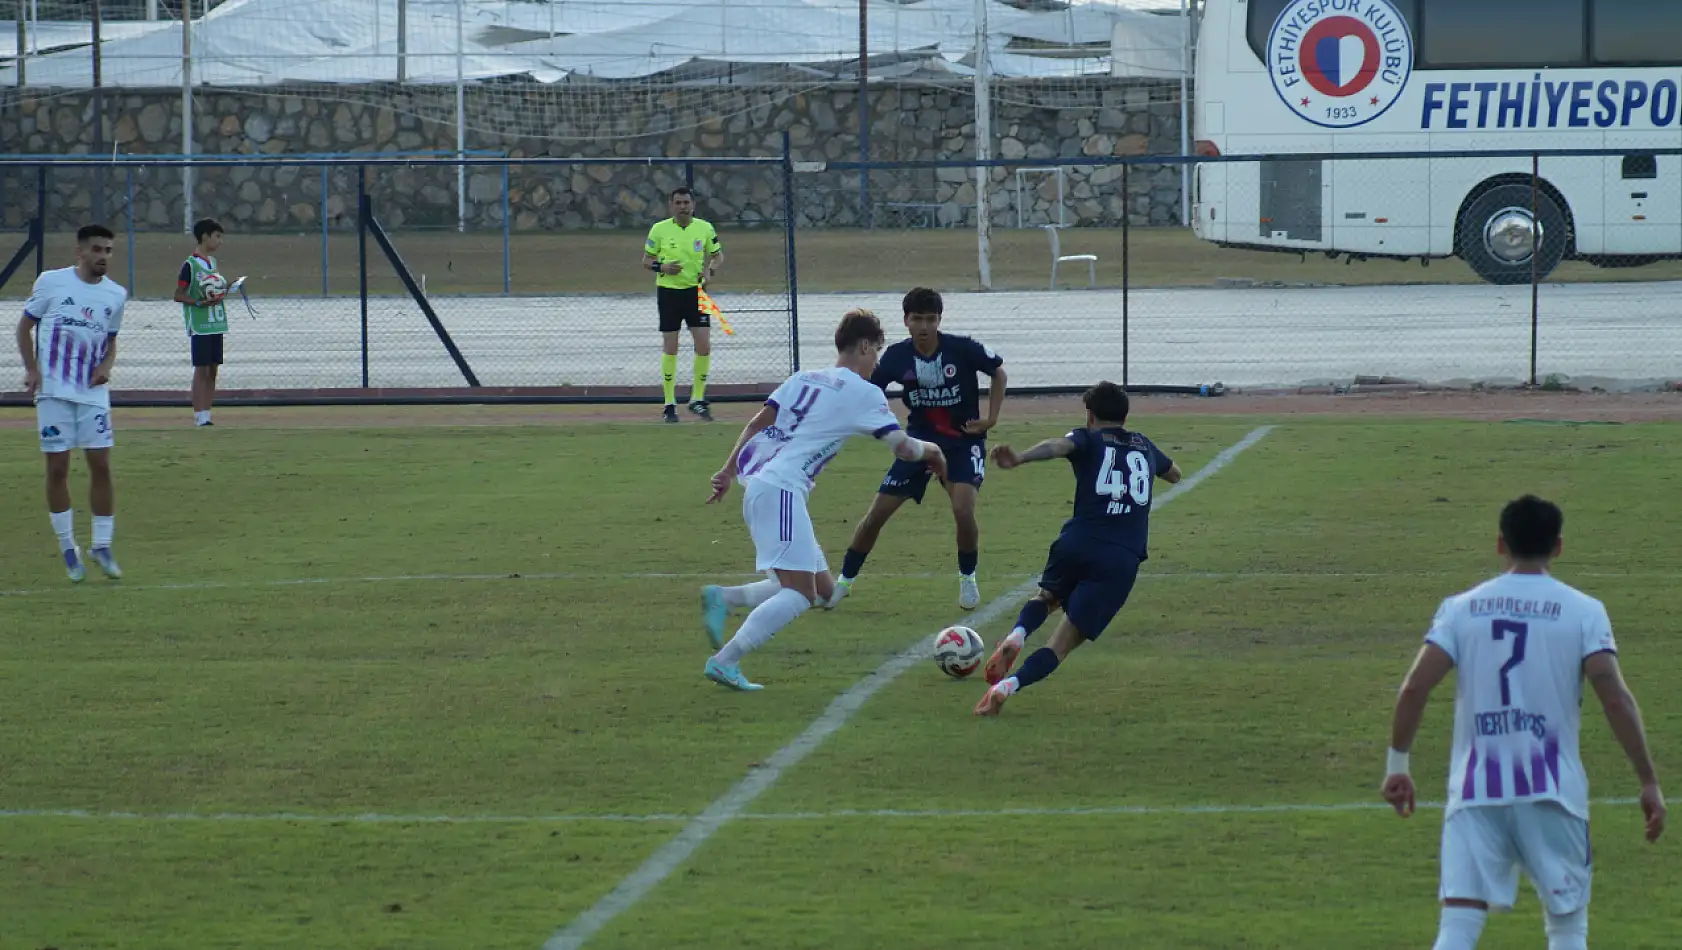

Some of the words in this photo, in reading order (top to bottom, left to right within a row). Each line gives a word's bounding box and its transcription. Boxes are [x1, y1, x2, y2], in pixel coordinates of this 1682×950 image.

[1278, 0, 1361, 88] FETHİYESPOR
[1364, 4, 1405, 85] KULÜBÜ
[1325, 106, 1358, 120] 1933
[1421, 73, 1682, 129] FETHİYESPO
[790, 384, 821, 432] 4
[908, 384, 960, 401] ESNAF
[1096, 446, 1150, 506] 48
[1491, 618, 1529, 706] 7
